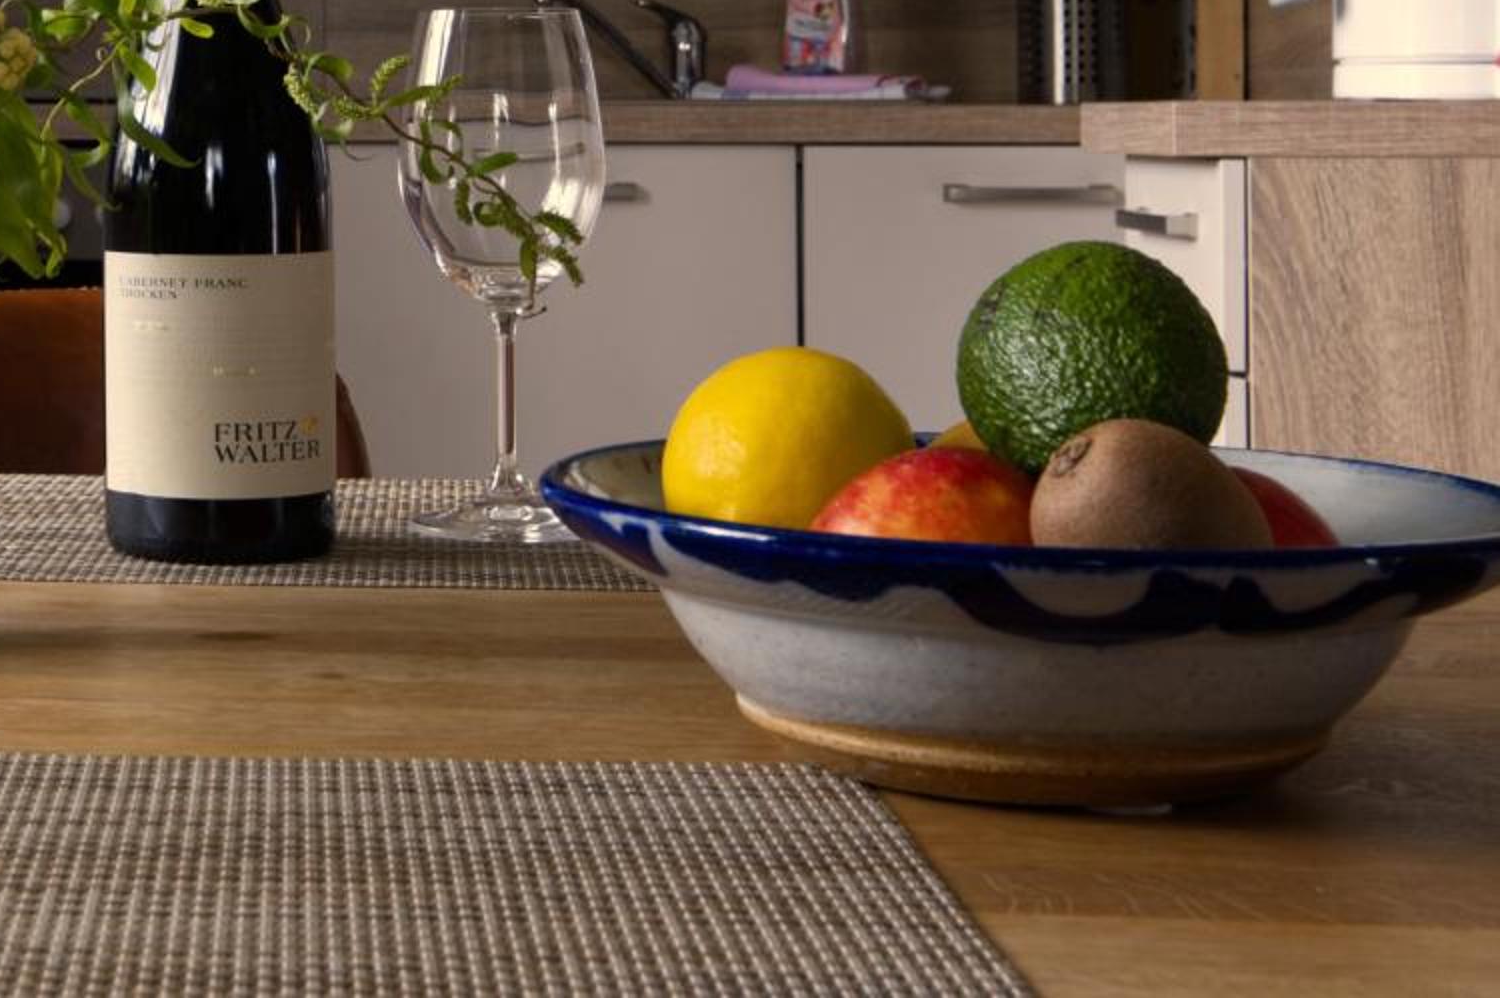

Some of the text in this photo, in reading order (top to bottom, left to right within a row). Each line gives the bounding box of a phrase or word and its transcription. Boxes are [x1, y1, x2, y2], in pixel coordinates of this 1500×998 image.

[194, 277, 249, 290] FRANC
[214, 420, 298, 442] FRITZ
[214, 440, 321, 463] WALTER
